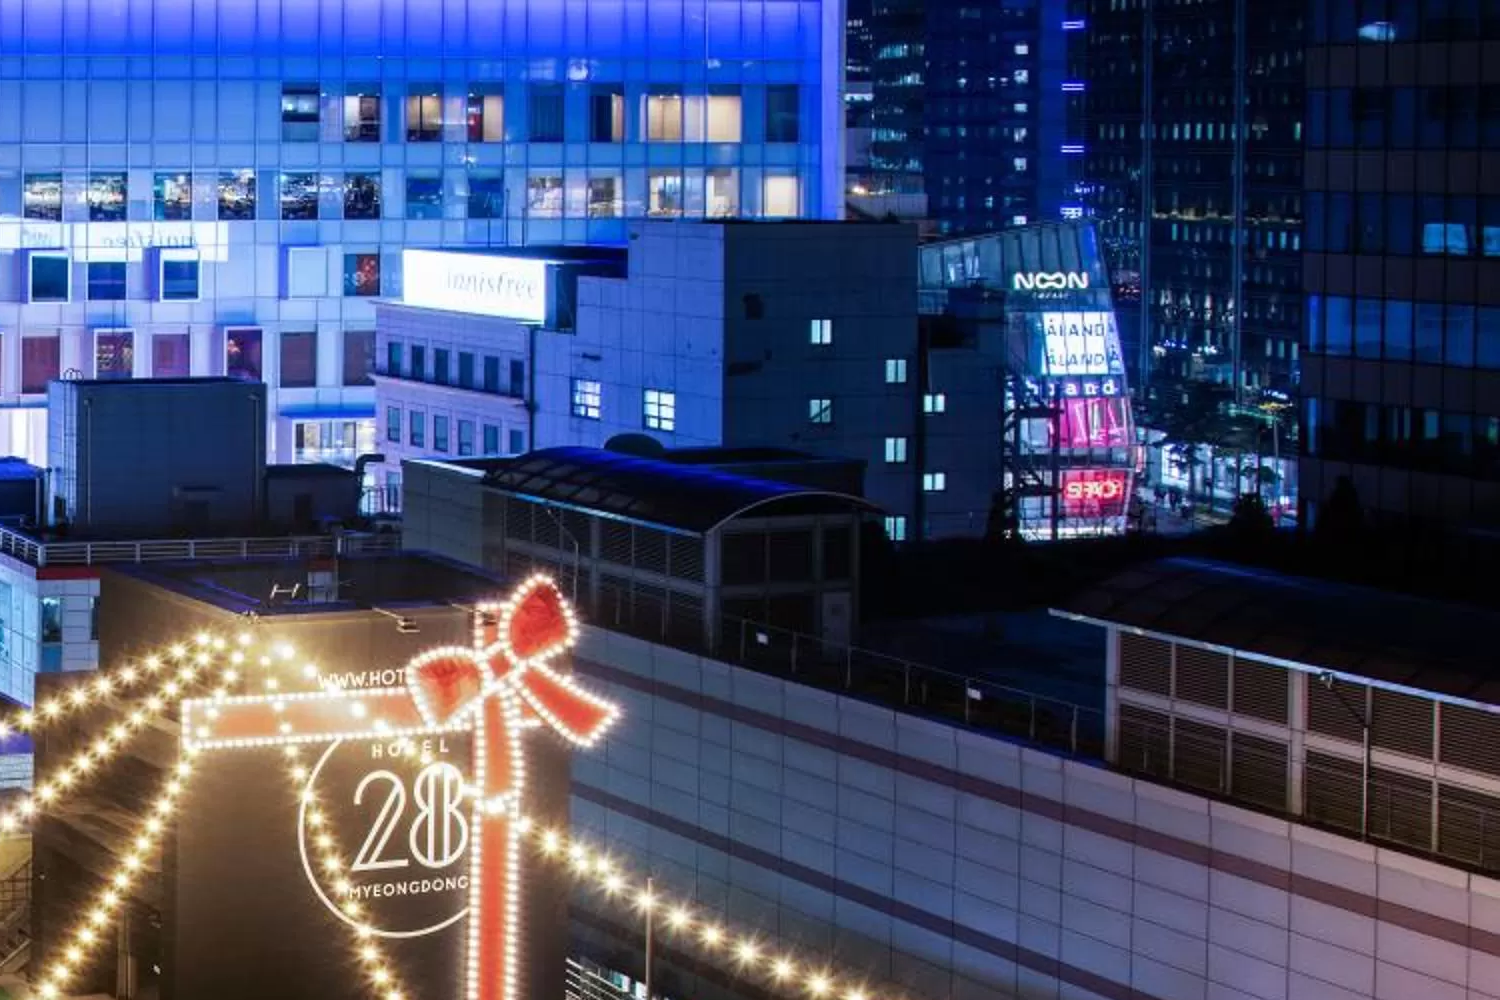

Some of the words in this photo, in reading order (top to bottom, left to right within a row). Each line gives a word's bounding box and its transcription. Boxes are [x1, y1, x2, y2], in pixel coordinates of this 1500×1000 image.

[446, 266, 538, 300] innisfree
[371, 738, 450, 759] HOEL
[352, 762, 469, 871] 28
[349, 874, 469, 899] MYEONGDONG
